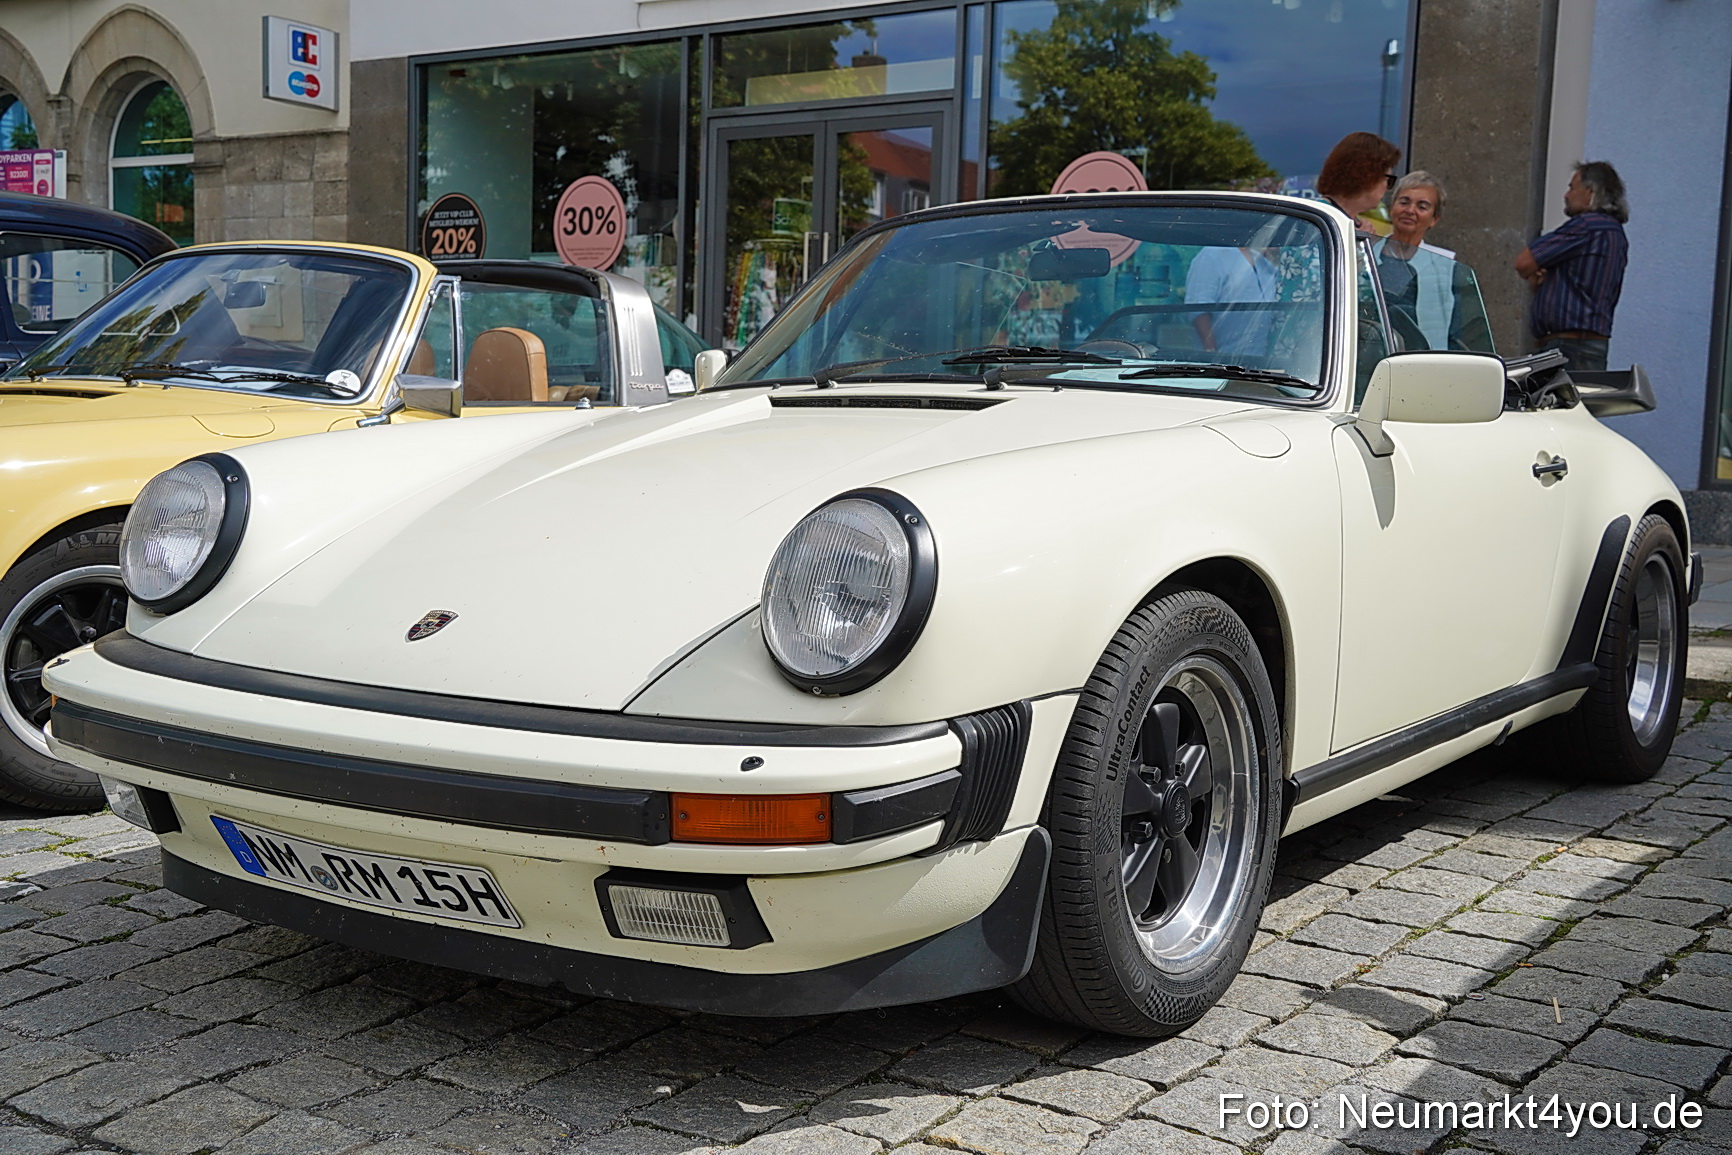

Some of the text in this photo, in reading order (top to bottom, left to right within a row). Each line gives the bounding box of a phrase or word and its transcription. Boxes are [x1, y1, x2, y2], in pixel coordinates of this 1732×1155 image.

[563, 205, 616, 236] 30%
[431, 227, 477, 255] 20%
[1106, 665, 1151, 781] UltraContact
[239, 850, 252, 863] D
[239, 829, 511, 920] NM RM 15H
